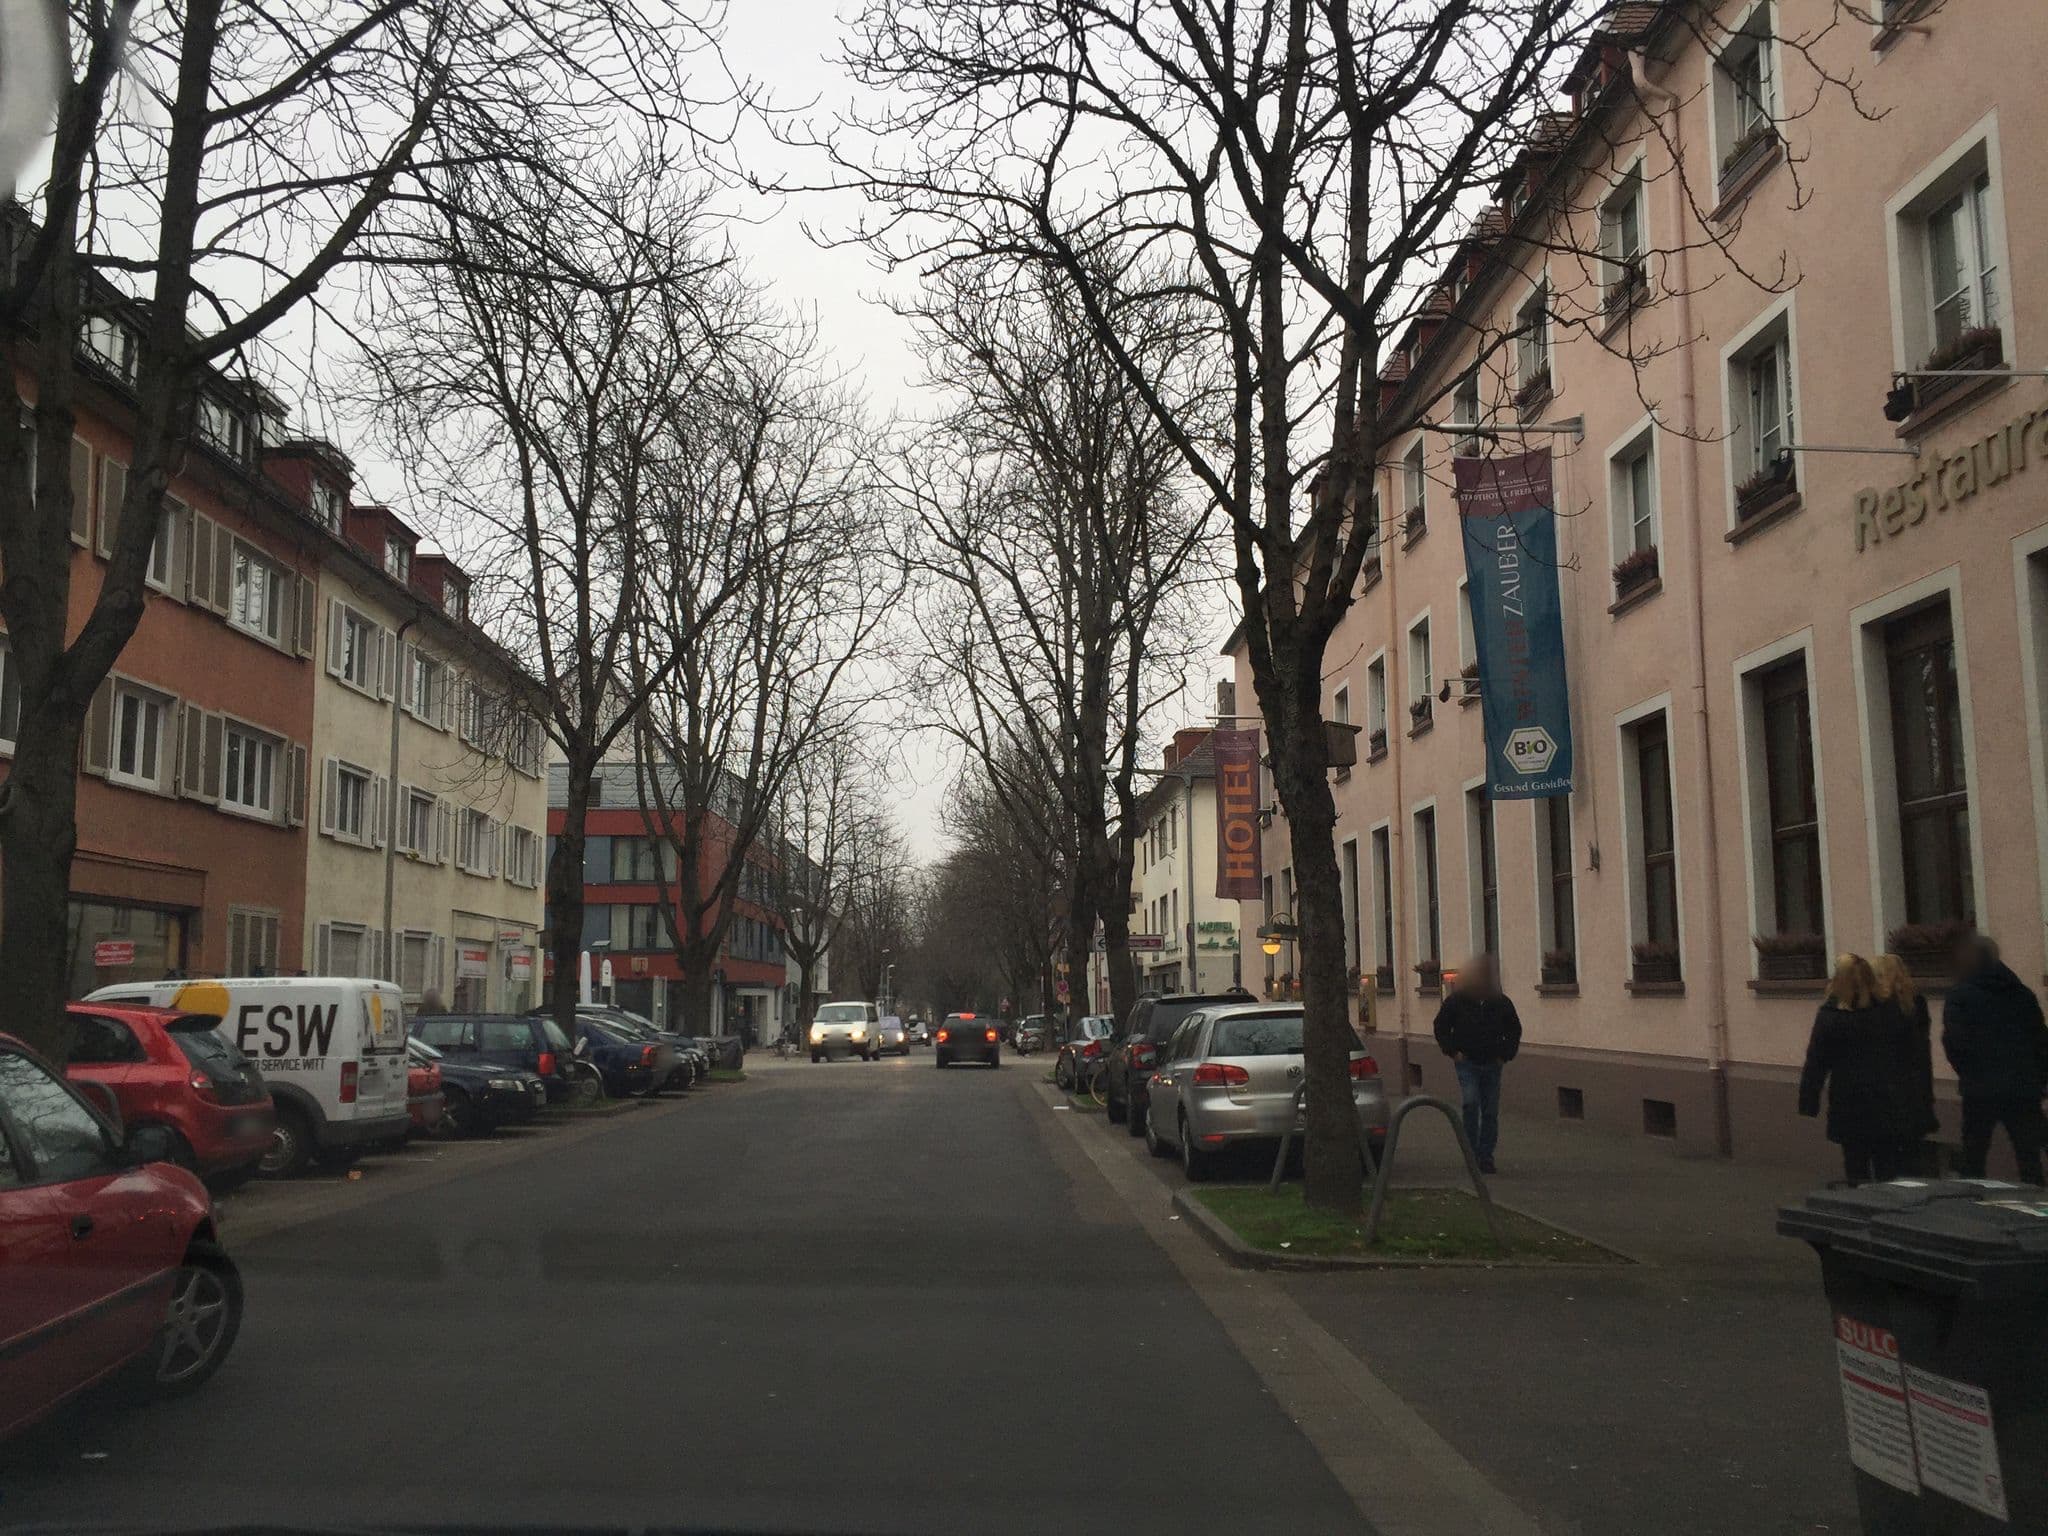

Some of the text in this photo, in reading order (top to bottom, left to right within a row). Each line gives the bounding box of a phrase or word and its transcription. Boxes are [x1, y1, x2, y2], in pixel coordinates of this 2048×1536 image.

[1497, 524, 1524, 619] ZAUBER
[1224, 760, 1254, 878] HOTEL
[236, 1004, 338, 1058] ESW
[261, 1058, 300, 1072] SERVICE
[302, 1057, 327, 1071] WITT
